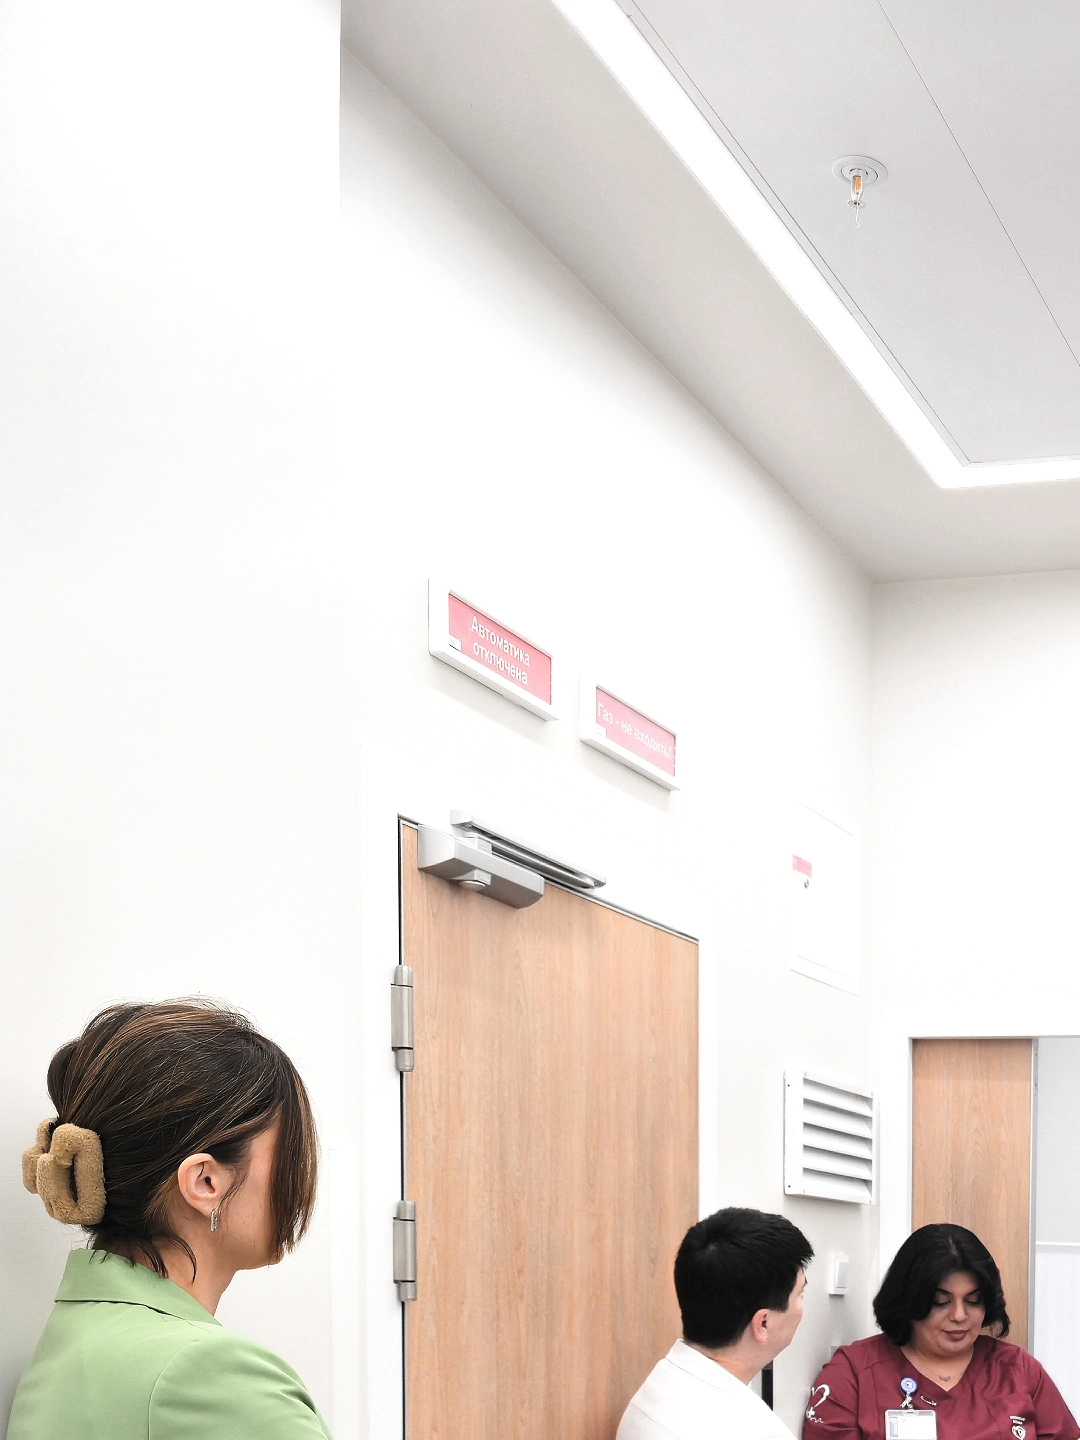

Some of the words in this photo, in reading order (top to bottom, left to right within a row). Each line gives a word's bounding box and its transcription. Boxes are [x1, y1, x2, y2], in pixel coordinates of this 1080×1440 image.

[470, 615, 531, 668] Автоматика
[472, 642, 529, 686] отключена
[597, 701, 614, 725] Газ
[621, 719, 632, 737] не
[634, 729, 673, 761] входить!
